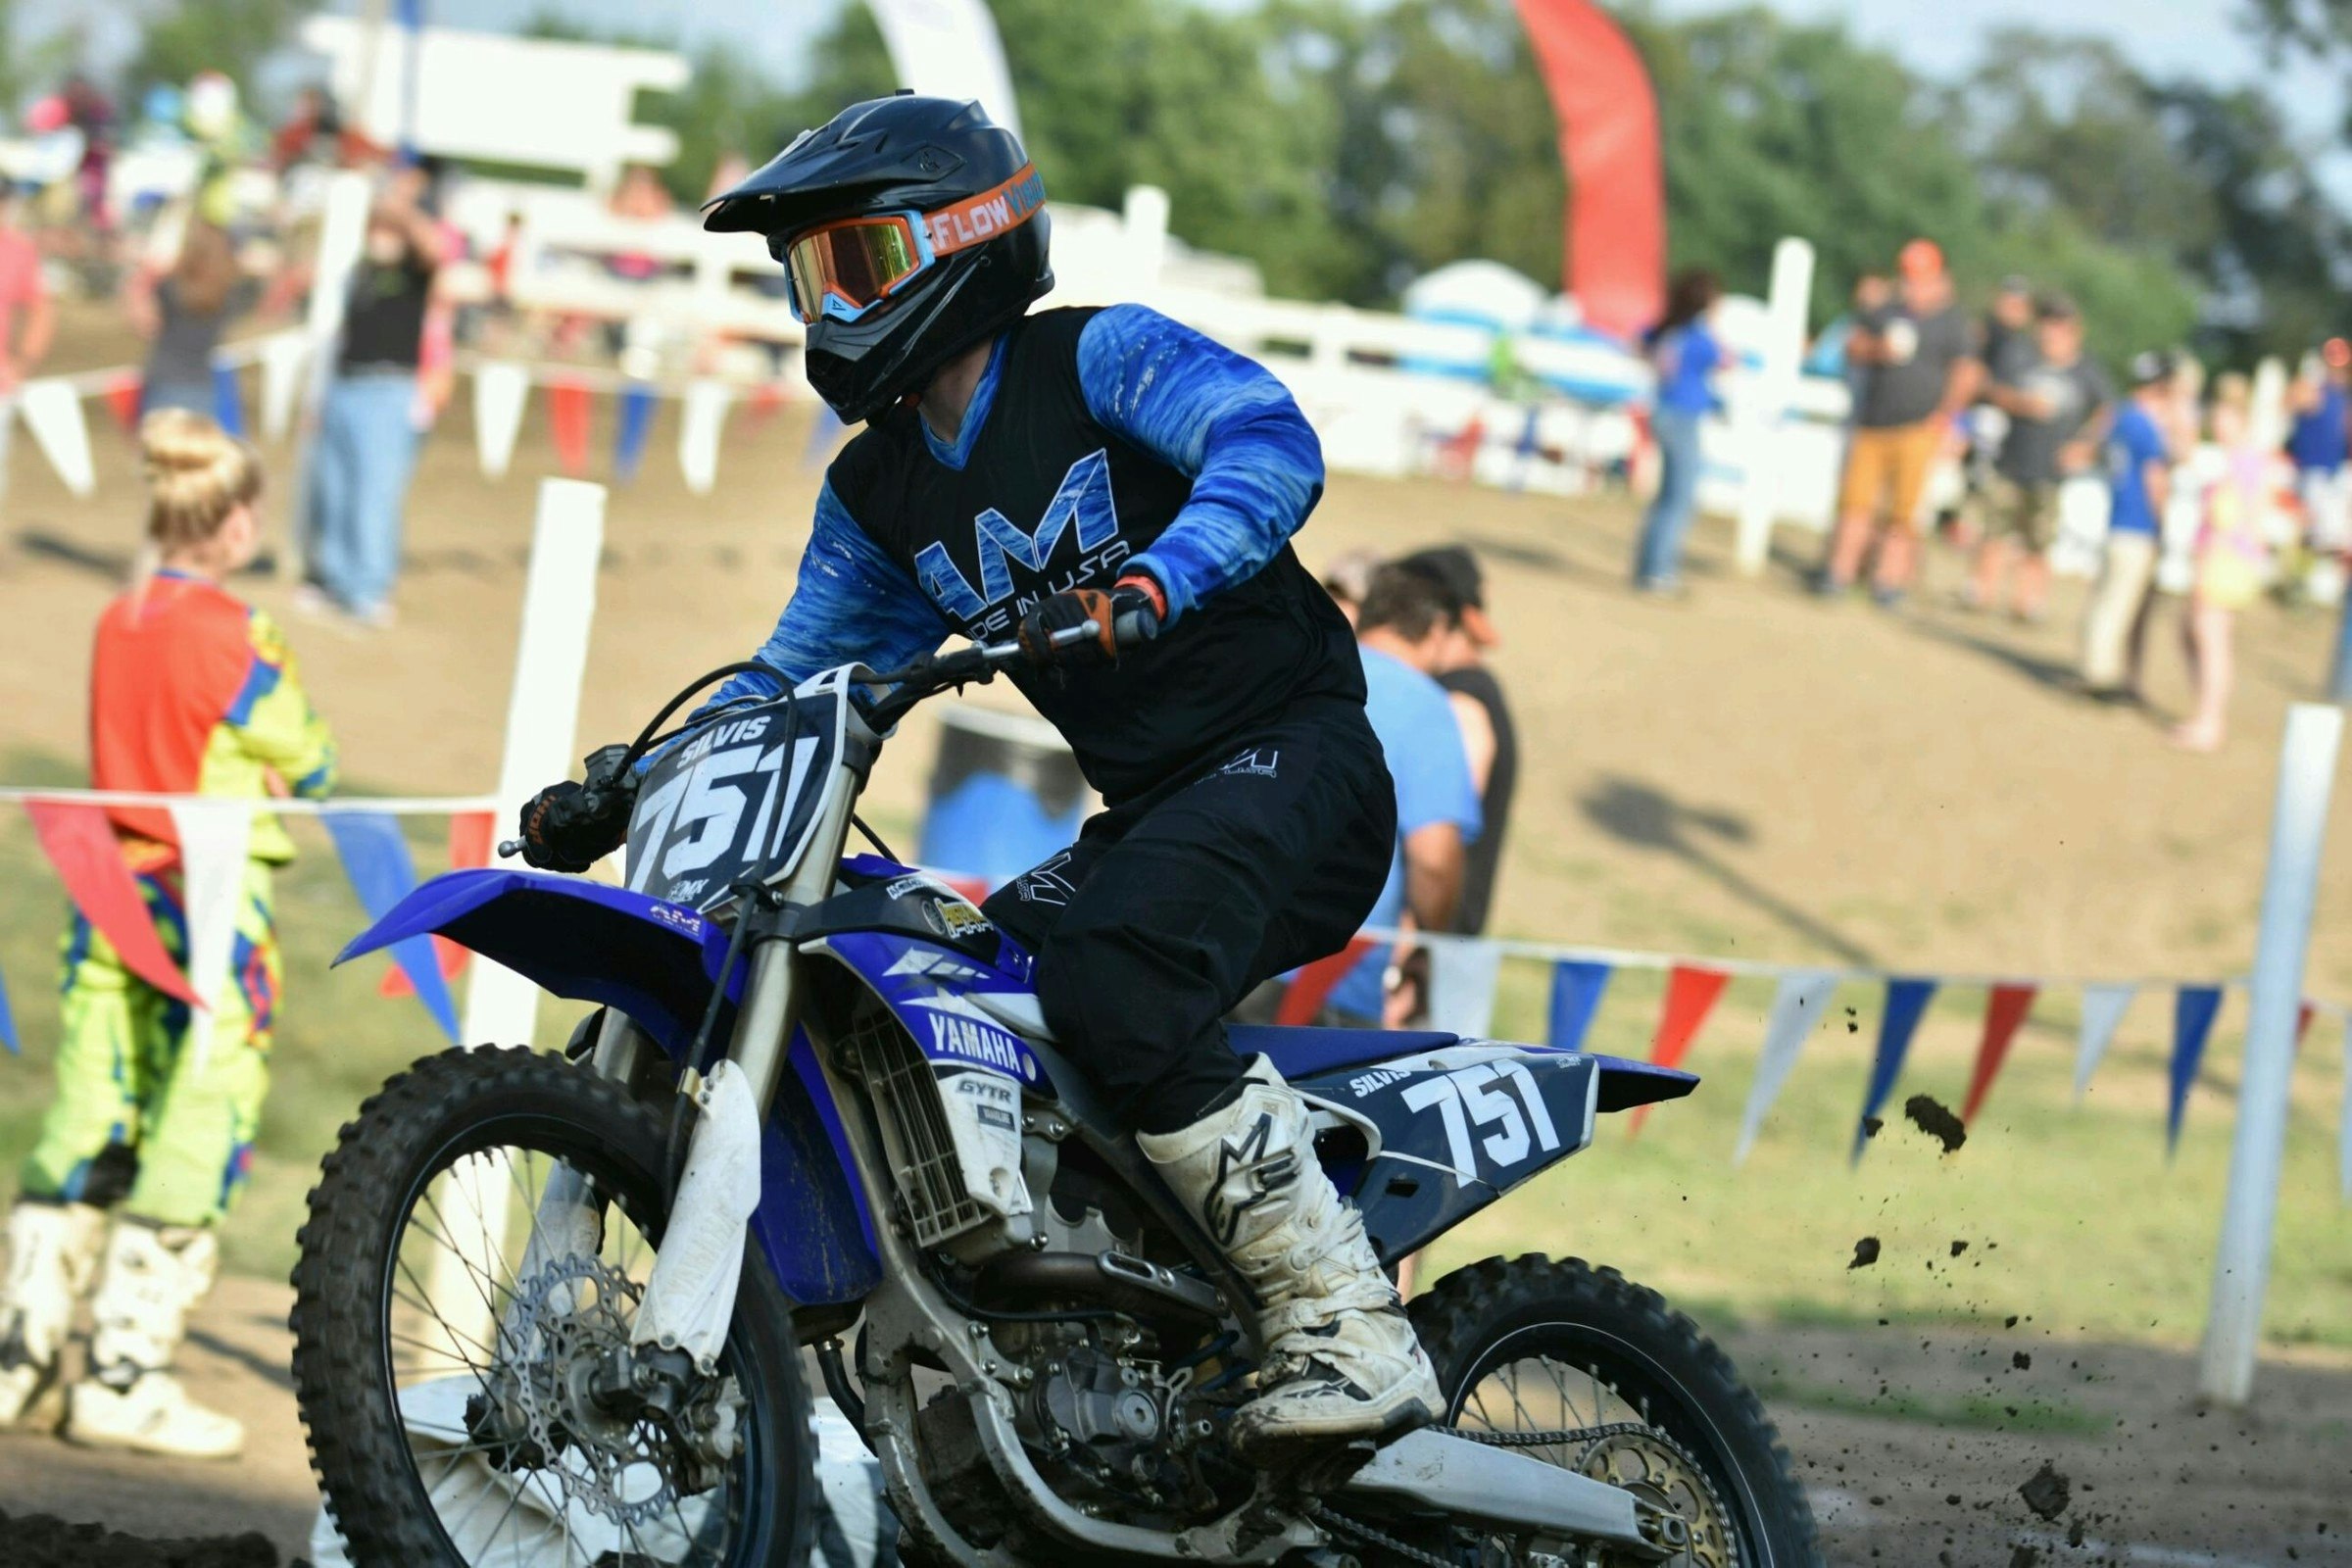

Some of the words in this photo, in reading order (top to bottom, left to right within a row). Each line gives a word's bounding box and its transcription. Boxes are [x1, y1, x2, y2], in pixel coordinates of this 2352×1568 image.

[1048, 540, 1130, 594] USA
[676, 715, 771, 769] SILVIS
[629, 736, 819, 894] 751
[928, 1012, 1021, 1073] YAMAHA
[957, 1079, 1011, 1102] GYTR
[1349, 1069, 1411, 1098] SILVIS
[1400, 1057, 1560, 1189] 751
